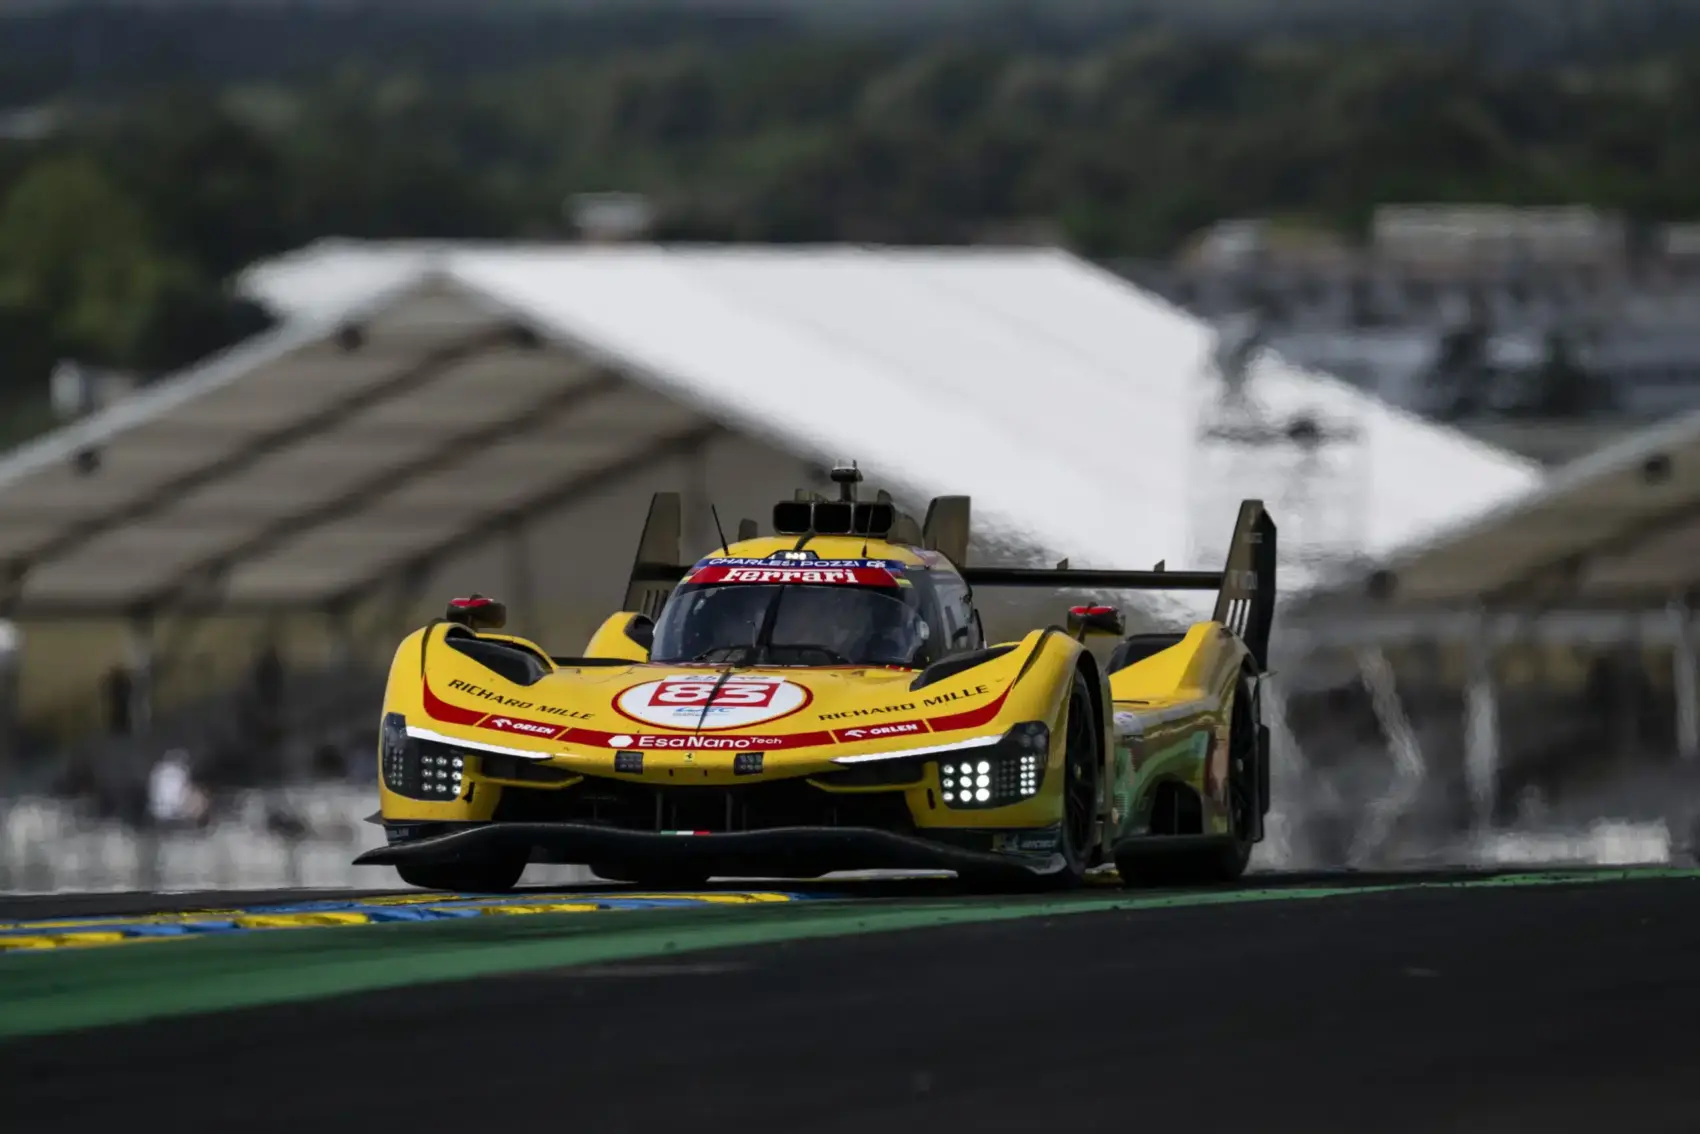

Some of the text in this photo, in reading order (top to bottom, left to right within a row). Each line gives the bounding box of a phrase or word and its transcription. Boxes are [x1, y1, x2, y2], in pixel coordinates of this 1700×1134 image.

[718, 567, 859, 583] Ferrari
[448, 679, 595, 720] RICHARD MILLE
[658, 683, 770, 704] 83
[818, 685, 989, 721] RICHARD MILLE
[512, 722, 555, 735] ORLEN
[870, 723, 918, 736] ORLEN
